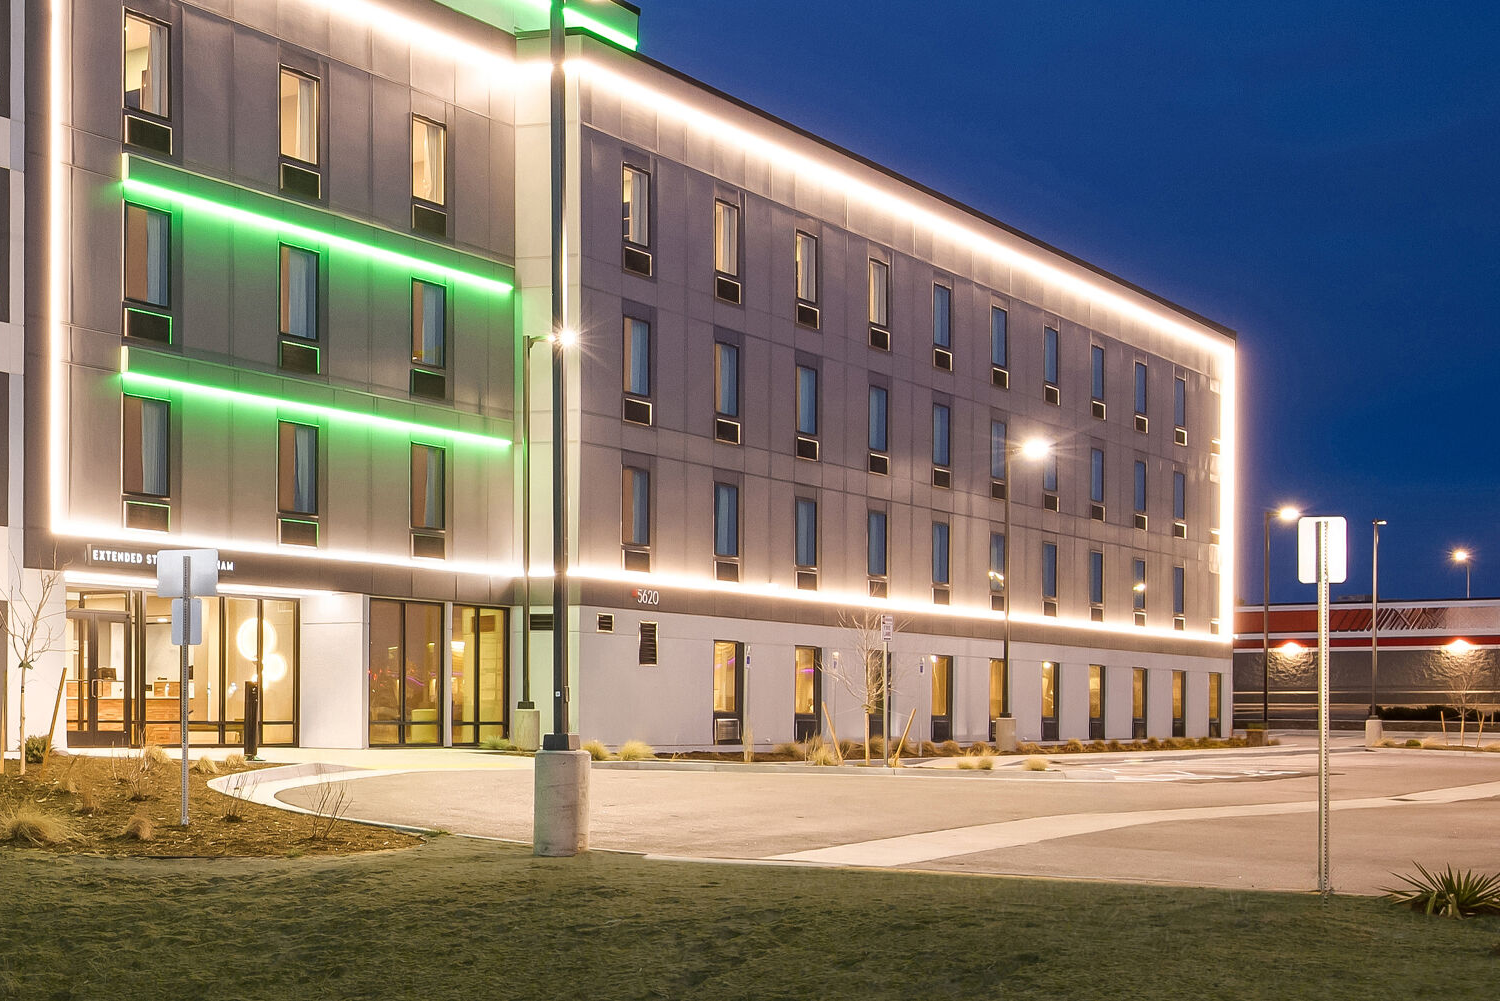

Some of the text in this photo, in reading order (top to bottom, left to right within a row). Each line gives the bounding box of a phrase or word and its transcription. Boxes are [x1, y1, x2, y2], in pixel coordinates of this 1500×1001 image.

[92, 549, 157, 565] EXTENDED ST
[637, 589, 659, 605] 5620
